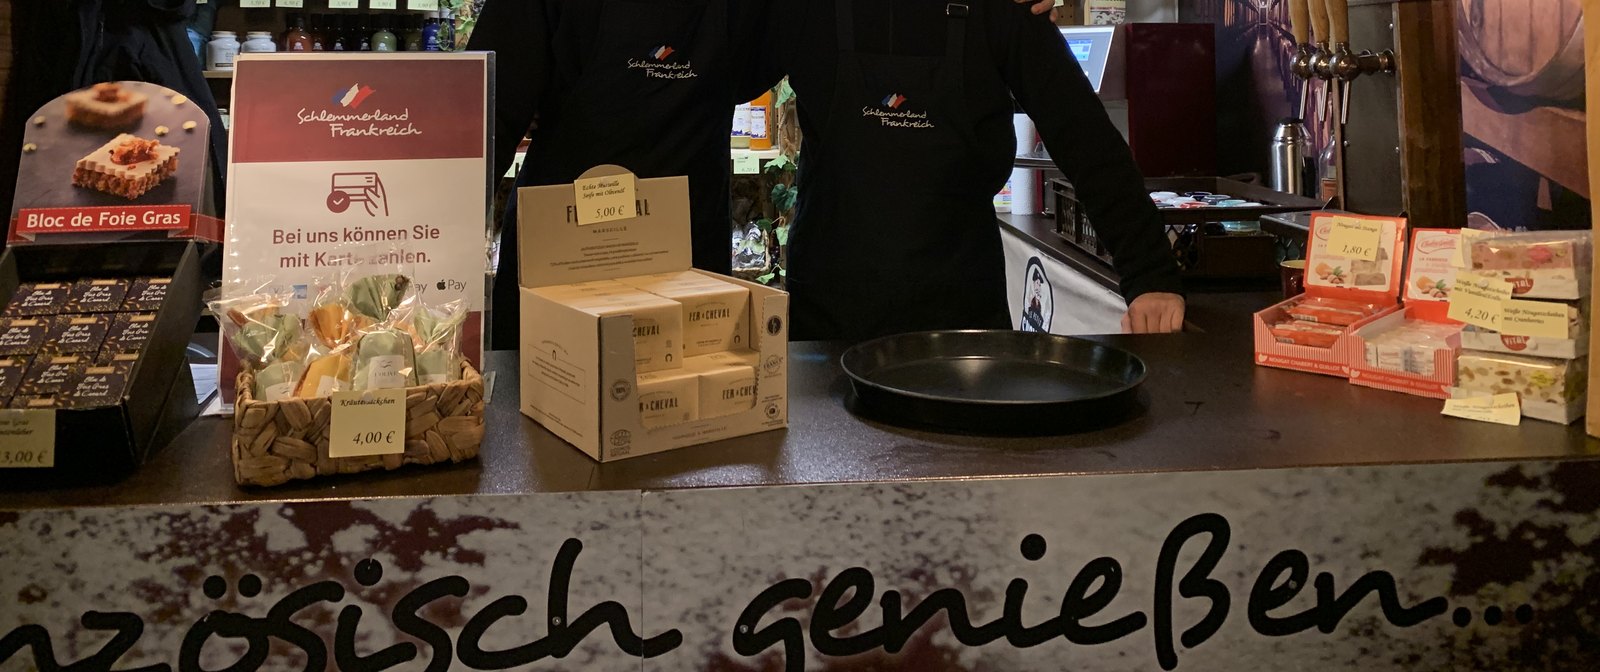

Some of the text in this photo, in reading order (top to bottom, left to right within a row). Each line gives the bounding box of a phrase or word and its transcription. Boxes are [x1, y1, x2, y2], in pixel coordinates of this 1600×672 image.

[627, 58, 690, 69] Schlemmerland
[646, 68, 698, 78] Frankreich
[297, 108, 408, 124] Schlemmerland
[862, 106, 926, 118] Schlemmerland
[881, 117, 934, 128] Frankreich
[329, 123, 422, 137] Frankreich
[27, 210, 181, 228] Bloc de Foie Gras
[594, 206, 615, 219] 5,00
[618, 205, 624, 215] €
[272, 225, 440, 244] Bei uns können Sie
[1342, 245, 1362, 254] 1,80
[280, 253, 309, 268] mit
[448, 280, 466, 292] Pay
[689, 310, 700, 322] FER
[706, 308, 730, 320] CHEVAL
[1464, 307, 1499, 324] 4,20 €
[740, 385, 757, 397] CHEV
[651, 398, 678, 411] CHEVAL
[352, 430, 395, 445] 4,00 €
[0, 451, 33, 464] 3,00
[731, 512, 1534, 672] genießen...
